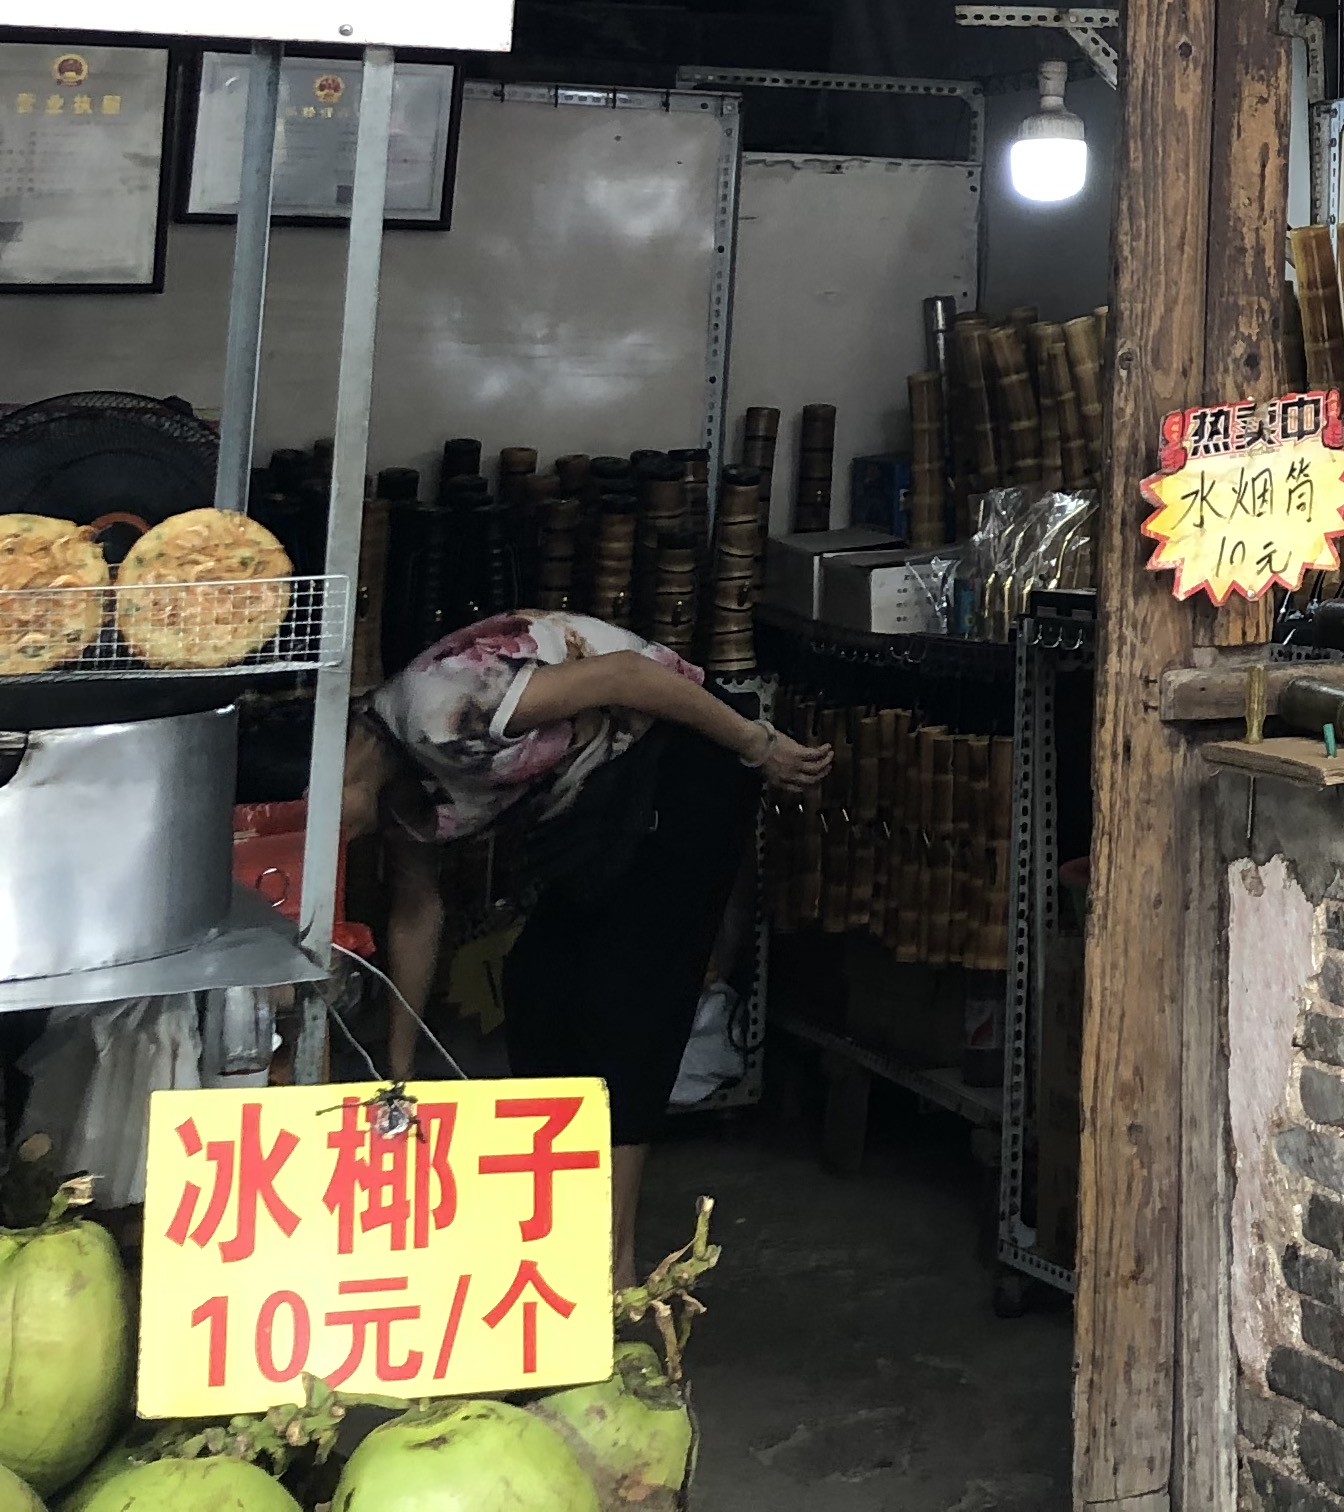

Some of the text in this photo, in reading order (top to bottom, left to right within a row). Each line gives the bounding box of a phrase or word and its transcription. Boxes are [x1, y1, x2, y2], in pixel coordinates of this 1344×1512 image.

[1190, 396, 1324, 457] 热卖中
[1171, 457, 1315, 531] 水烟筒
[164, 1096, 600, 1263] 冰椰子
[190, 1259, 578, 1390] 10元/个
